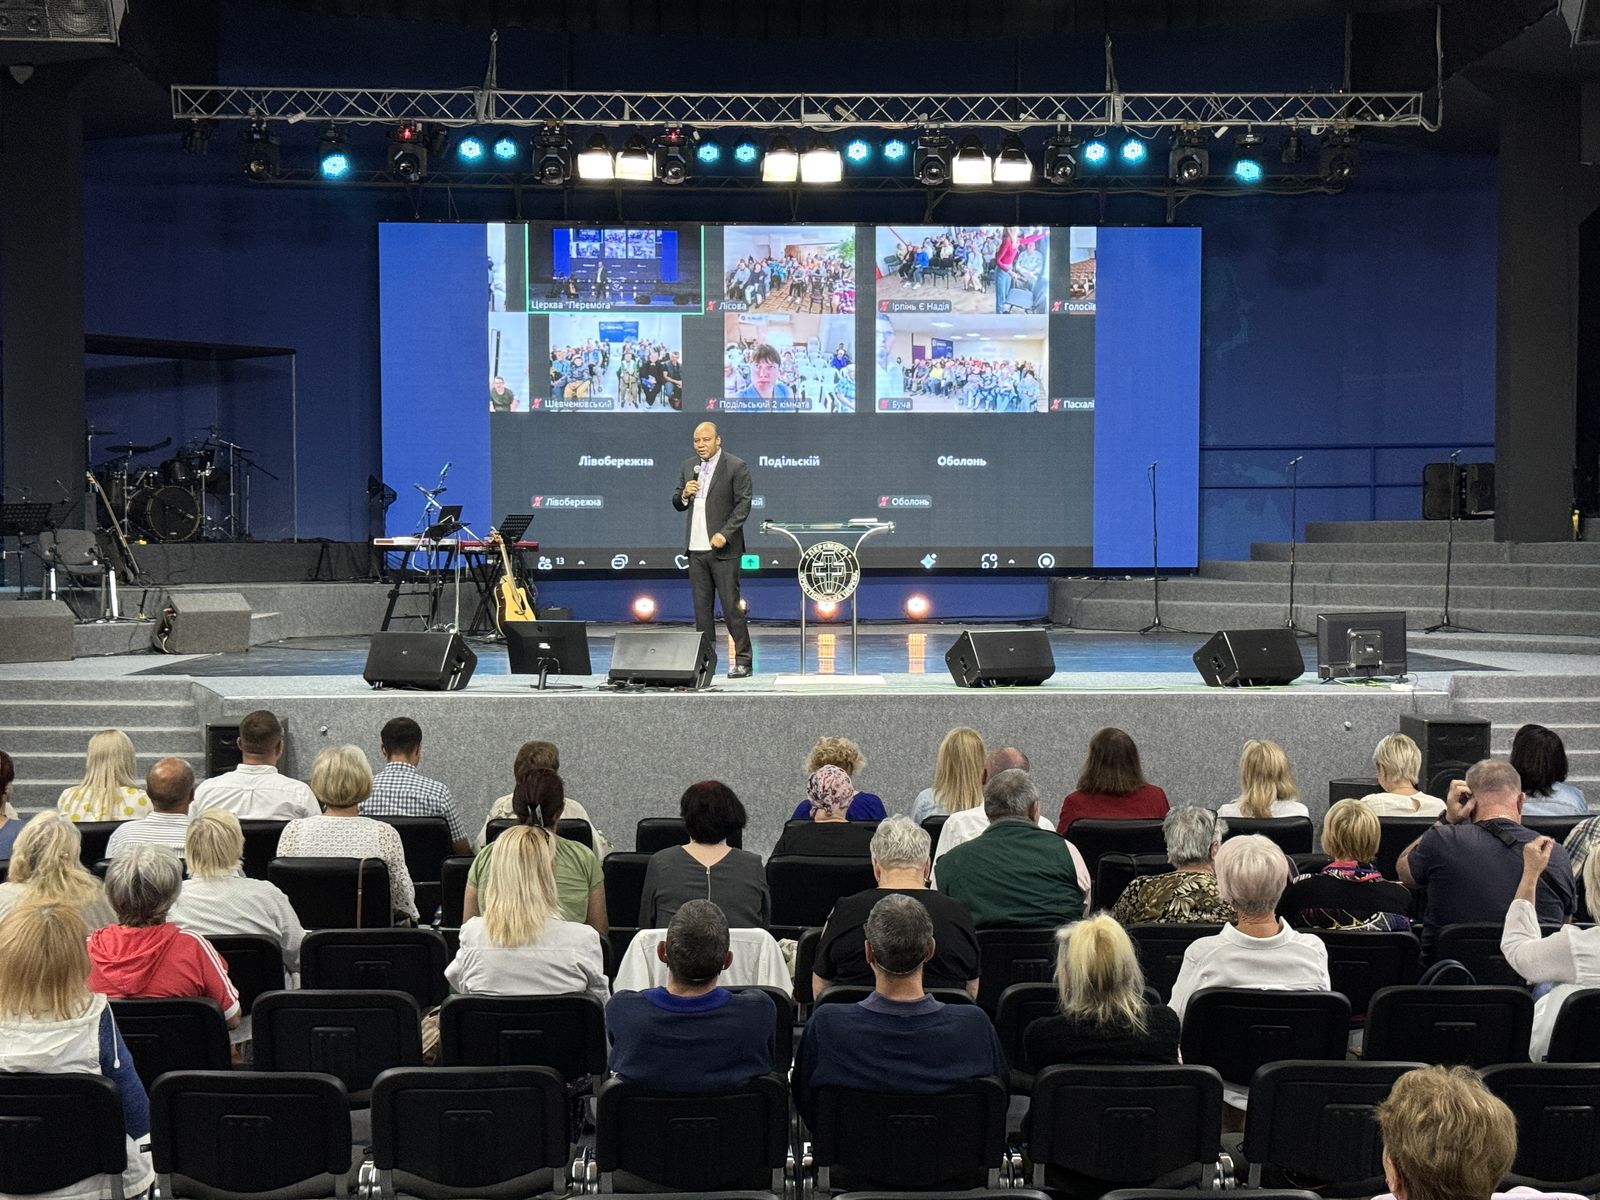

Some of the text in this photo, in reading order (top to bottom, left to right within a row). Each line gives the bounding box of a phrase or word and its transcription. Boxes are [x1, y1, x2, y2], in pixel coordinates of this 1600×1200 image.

[531, 300, 614, 313] Церква "Перемога"
[718, 301, 747, 311] Лісова
[892, 302, 950, 313] Ірпінь Є Надія
[719, 399, 770, 411] Подільський
[772, 399, 778, 410] 2
[892, 400, 911, 412] Буча
[578, 455, 654, 468] Лівобережна
[759, 455, 820, 469] Подільскій
[937, 455, 987, 467] Оболонь
[545, 497, 602, 508] Лівобережна
[891, 497, 930, 507] Оболонь
[808, 544, 848, 557] ПЕРЕМОГА
[555, 556, 565, 566] 13
